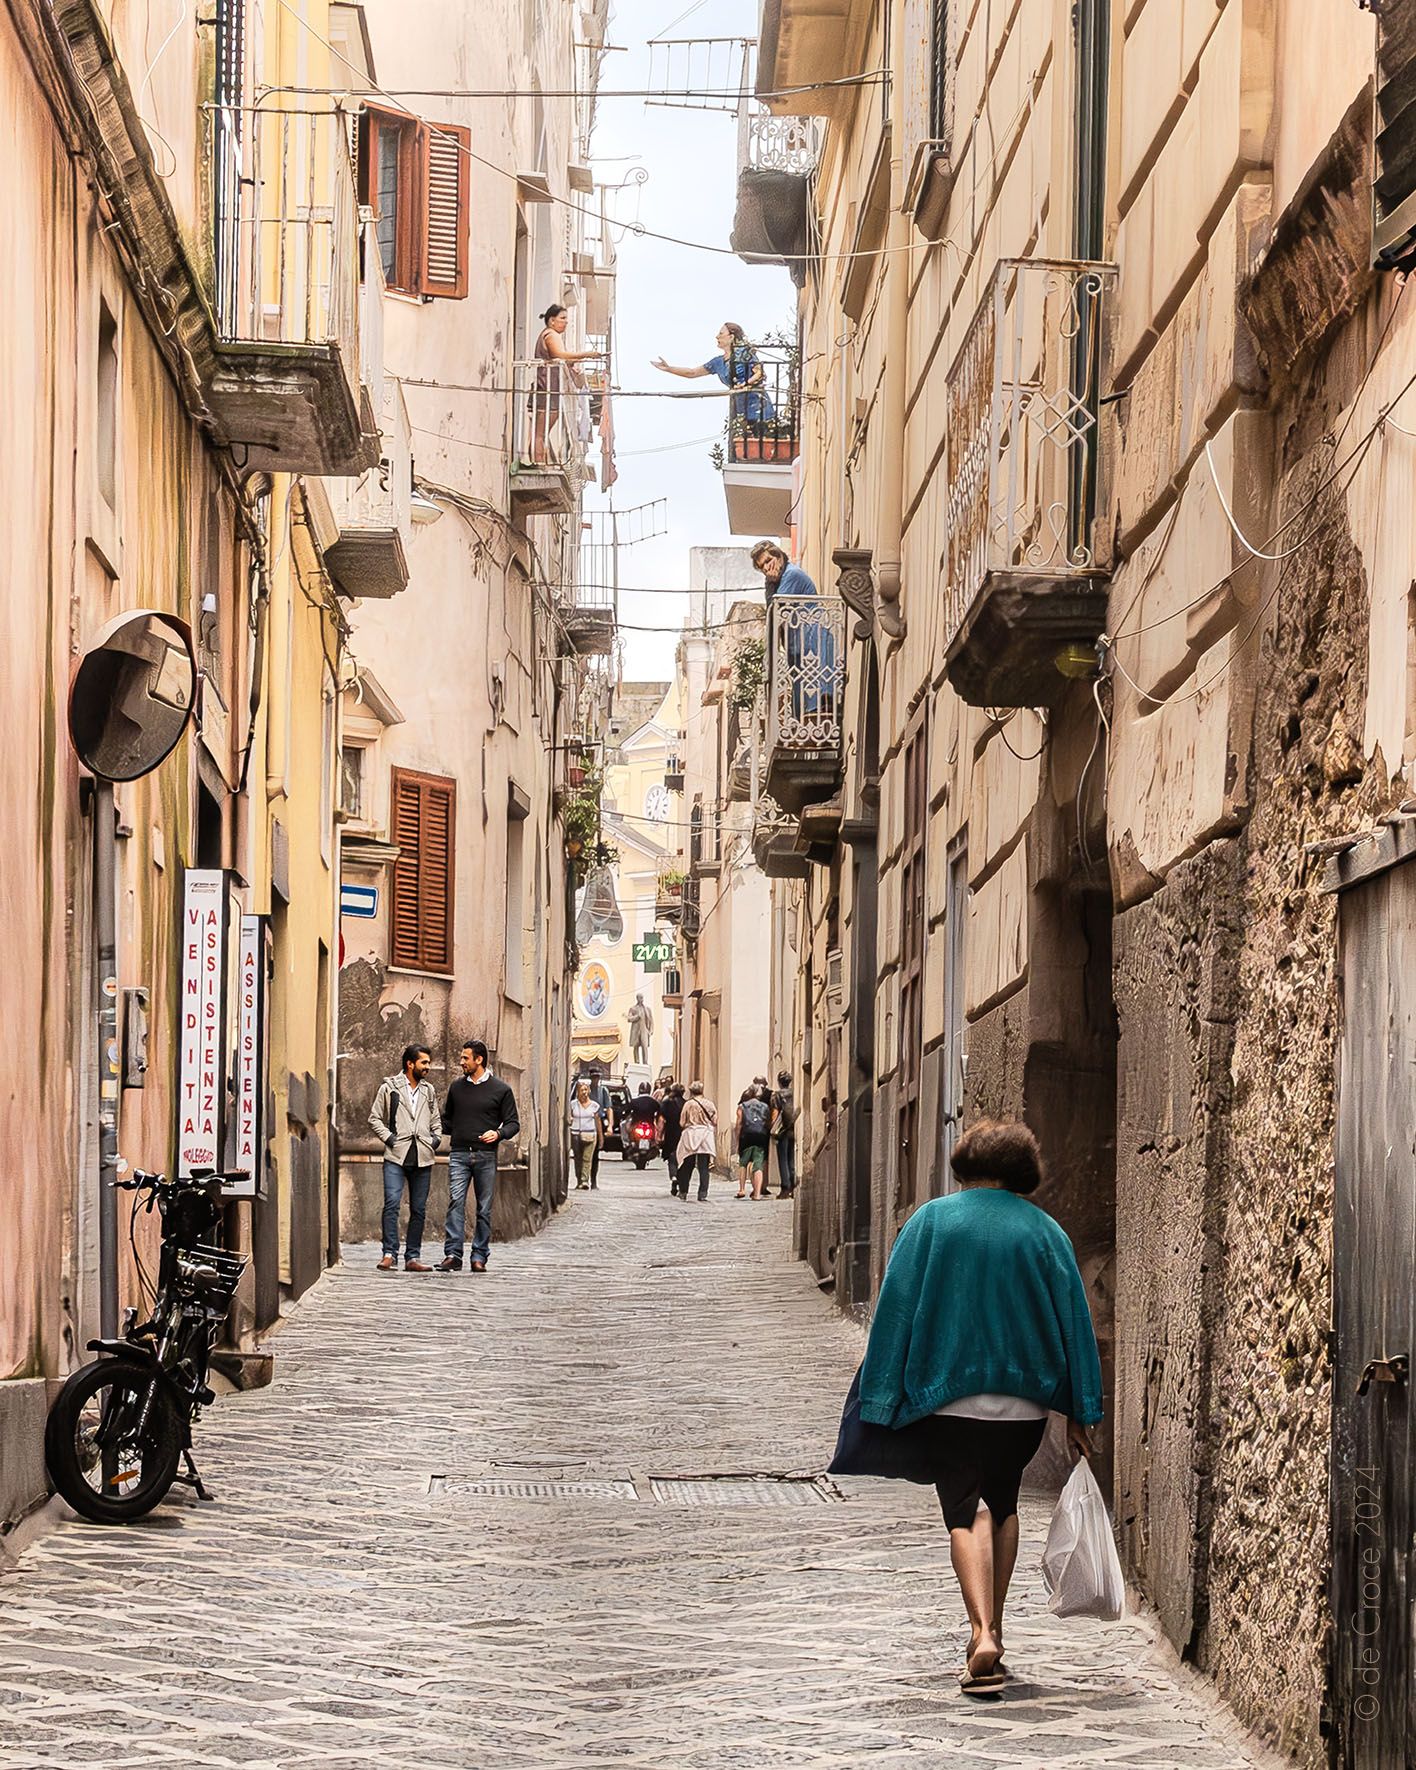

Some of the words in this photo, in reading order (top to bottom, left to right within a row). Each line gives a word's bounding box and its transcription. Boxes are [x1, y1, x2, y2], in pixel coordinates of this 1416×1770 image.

[184, 909, 199, 1133] VENDITA
[203, 909, 217, 1134] ASSISTENZA
[242, 952, 255, 1155] ASSISTENZA
[636, 944, 669, 961] 21/10
